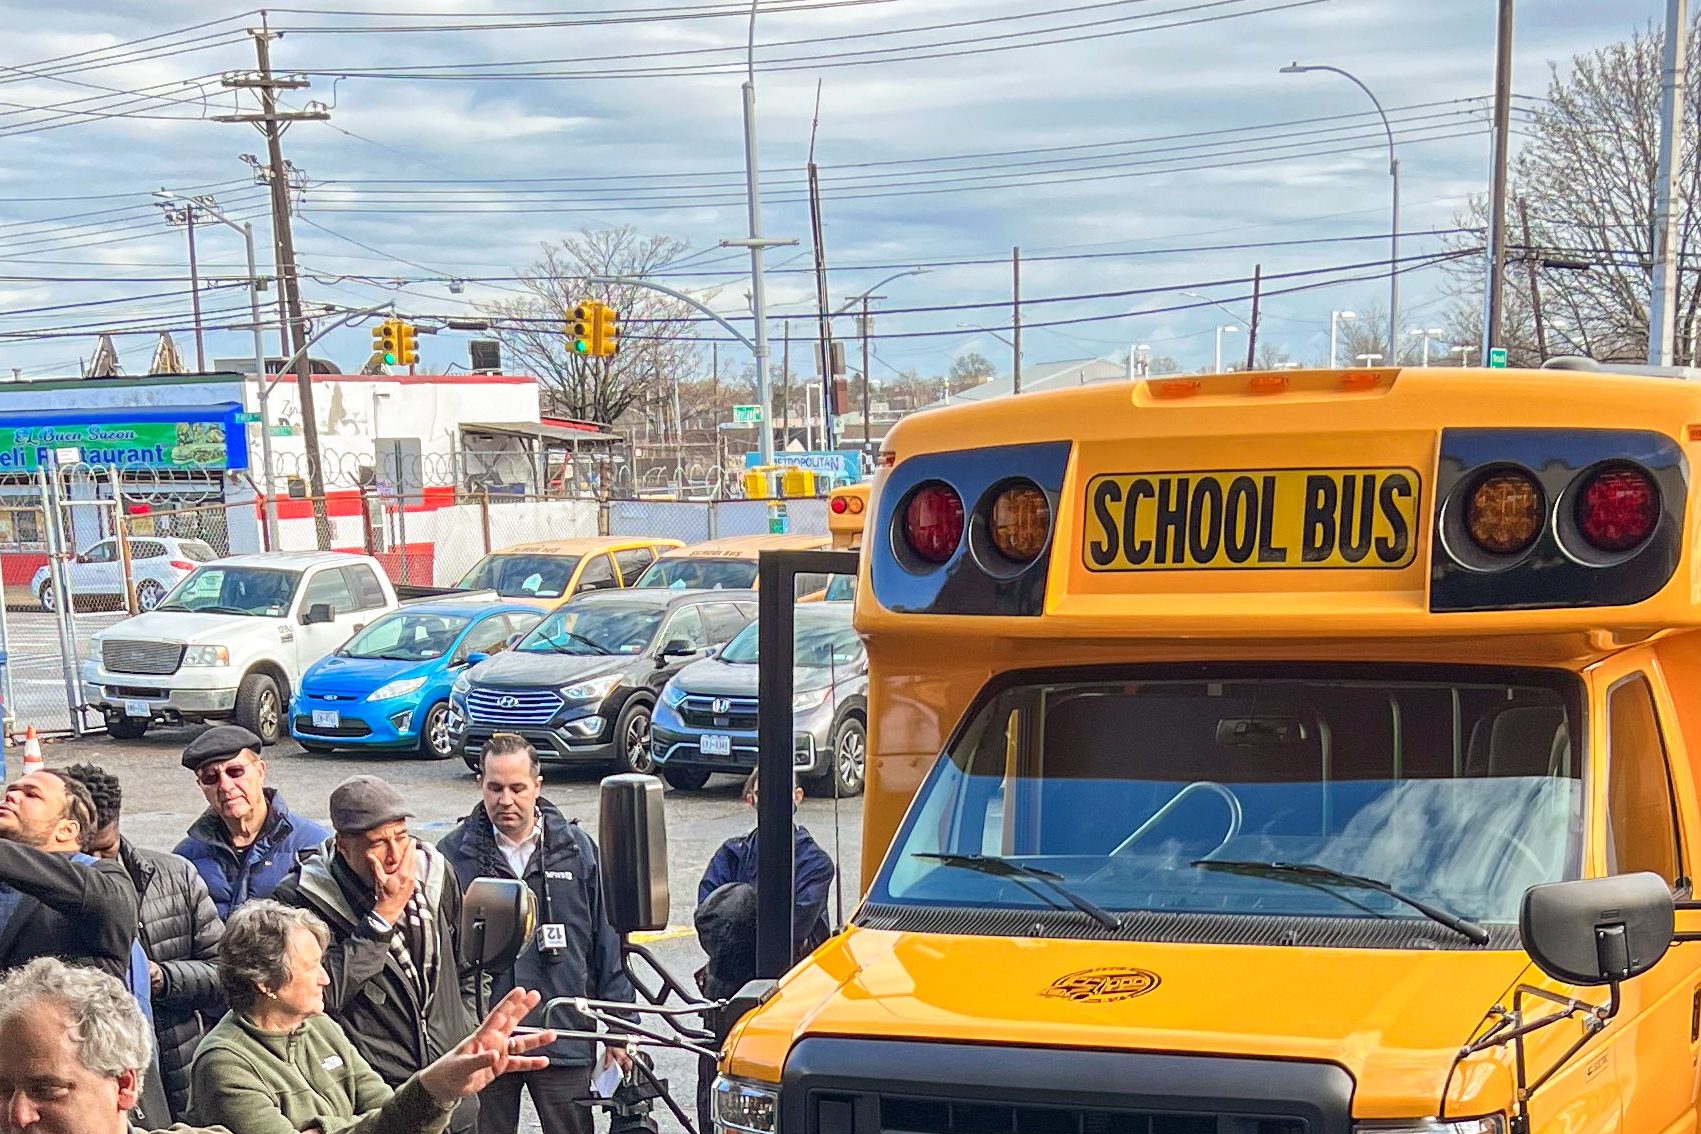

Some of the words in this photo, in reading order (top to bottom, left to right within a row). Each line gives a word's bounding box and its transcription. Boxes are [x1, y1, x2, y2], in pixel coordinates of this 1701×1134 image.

[36, 444, 164, 466] Rtaurant
[1091, 475, 1287, 566] SCHOOL
[1301, 474, 1412, 563] BUS
